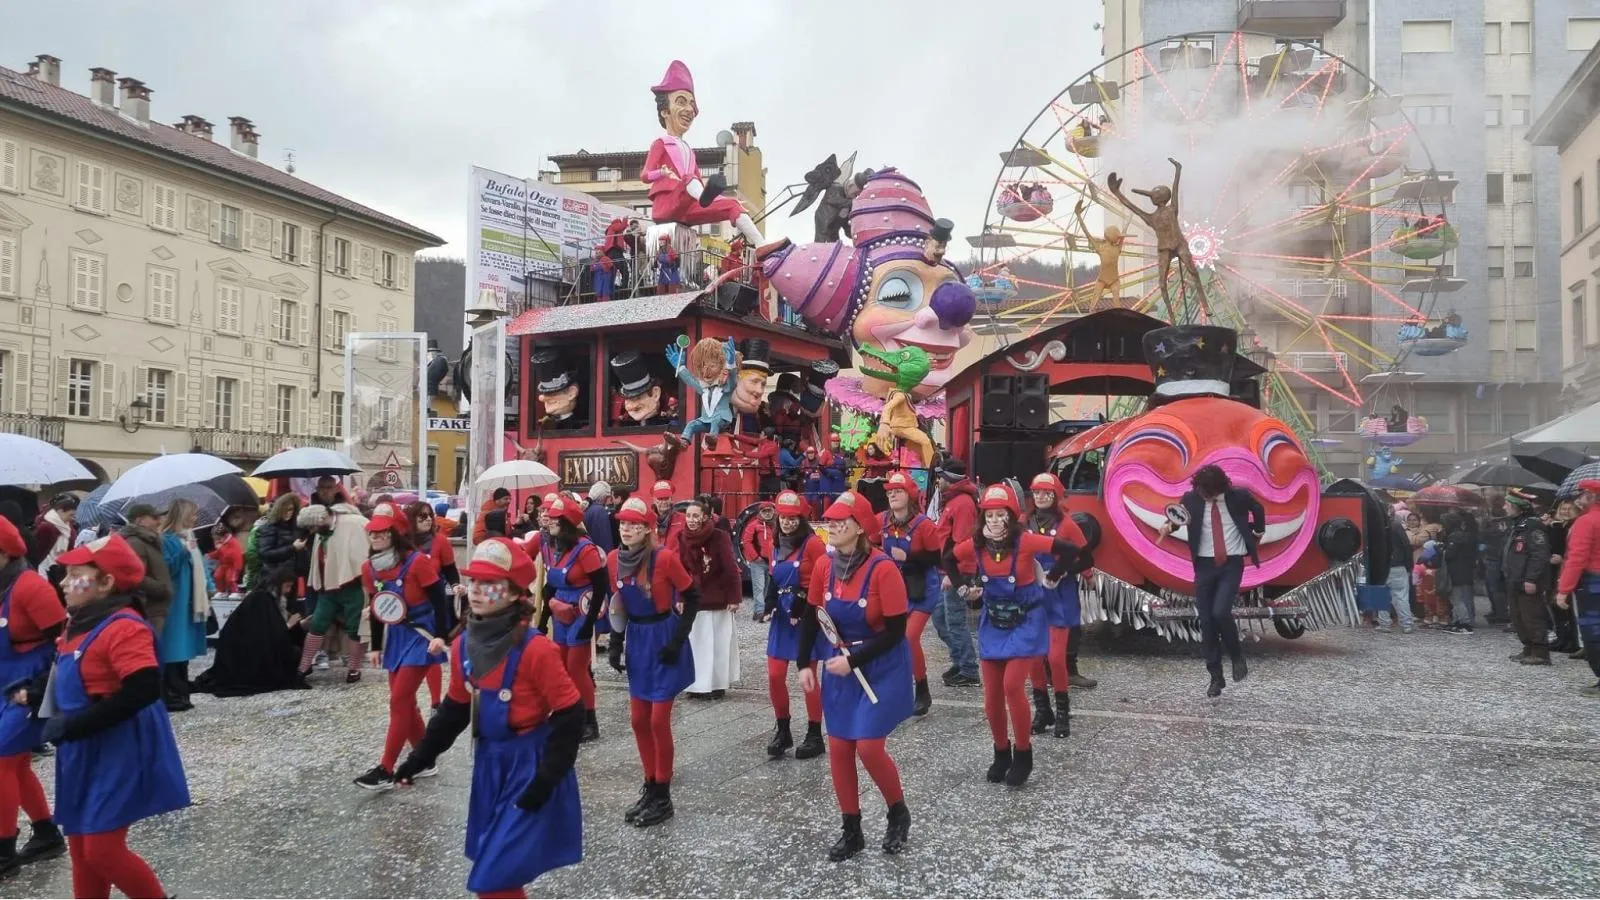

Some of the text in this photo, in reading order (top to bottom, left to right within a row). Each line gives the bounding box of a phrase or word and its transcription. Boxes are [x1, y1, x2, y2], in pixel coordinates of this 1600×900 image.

[486, 180, 559, 206] Bufala Oggi
[430, 419, 471, 429] FAKE
[388, 474, 396, 482] 30
[564, 455, 629, 485] EXPRESS
